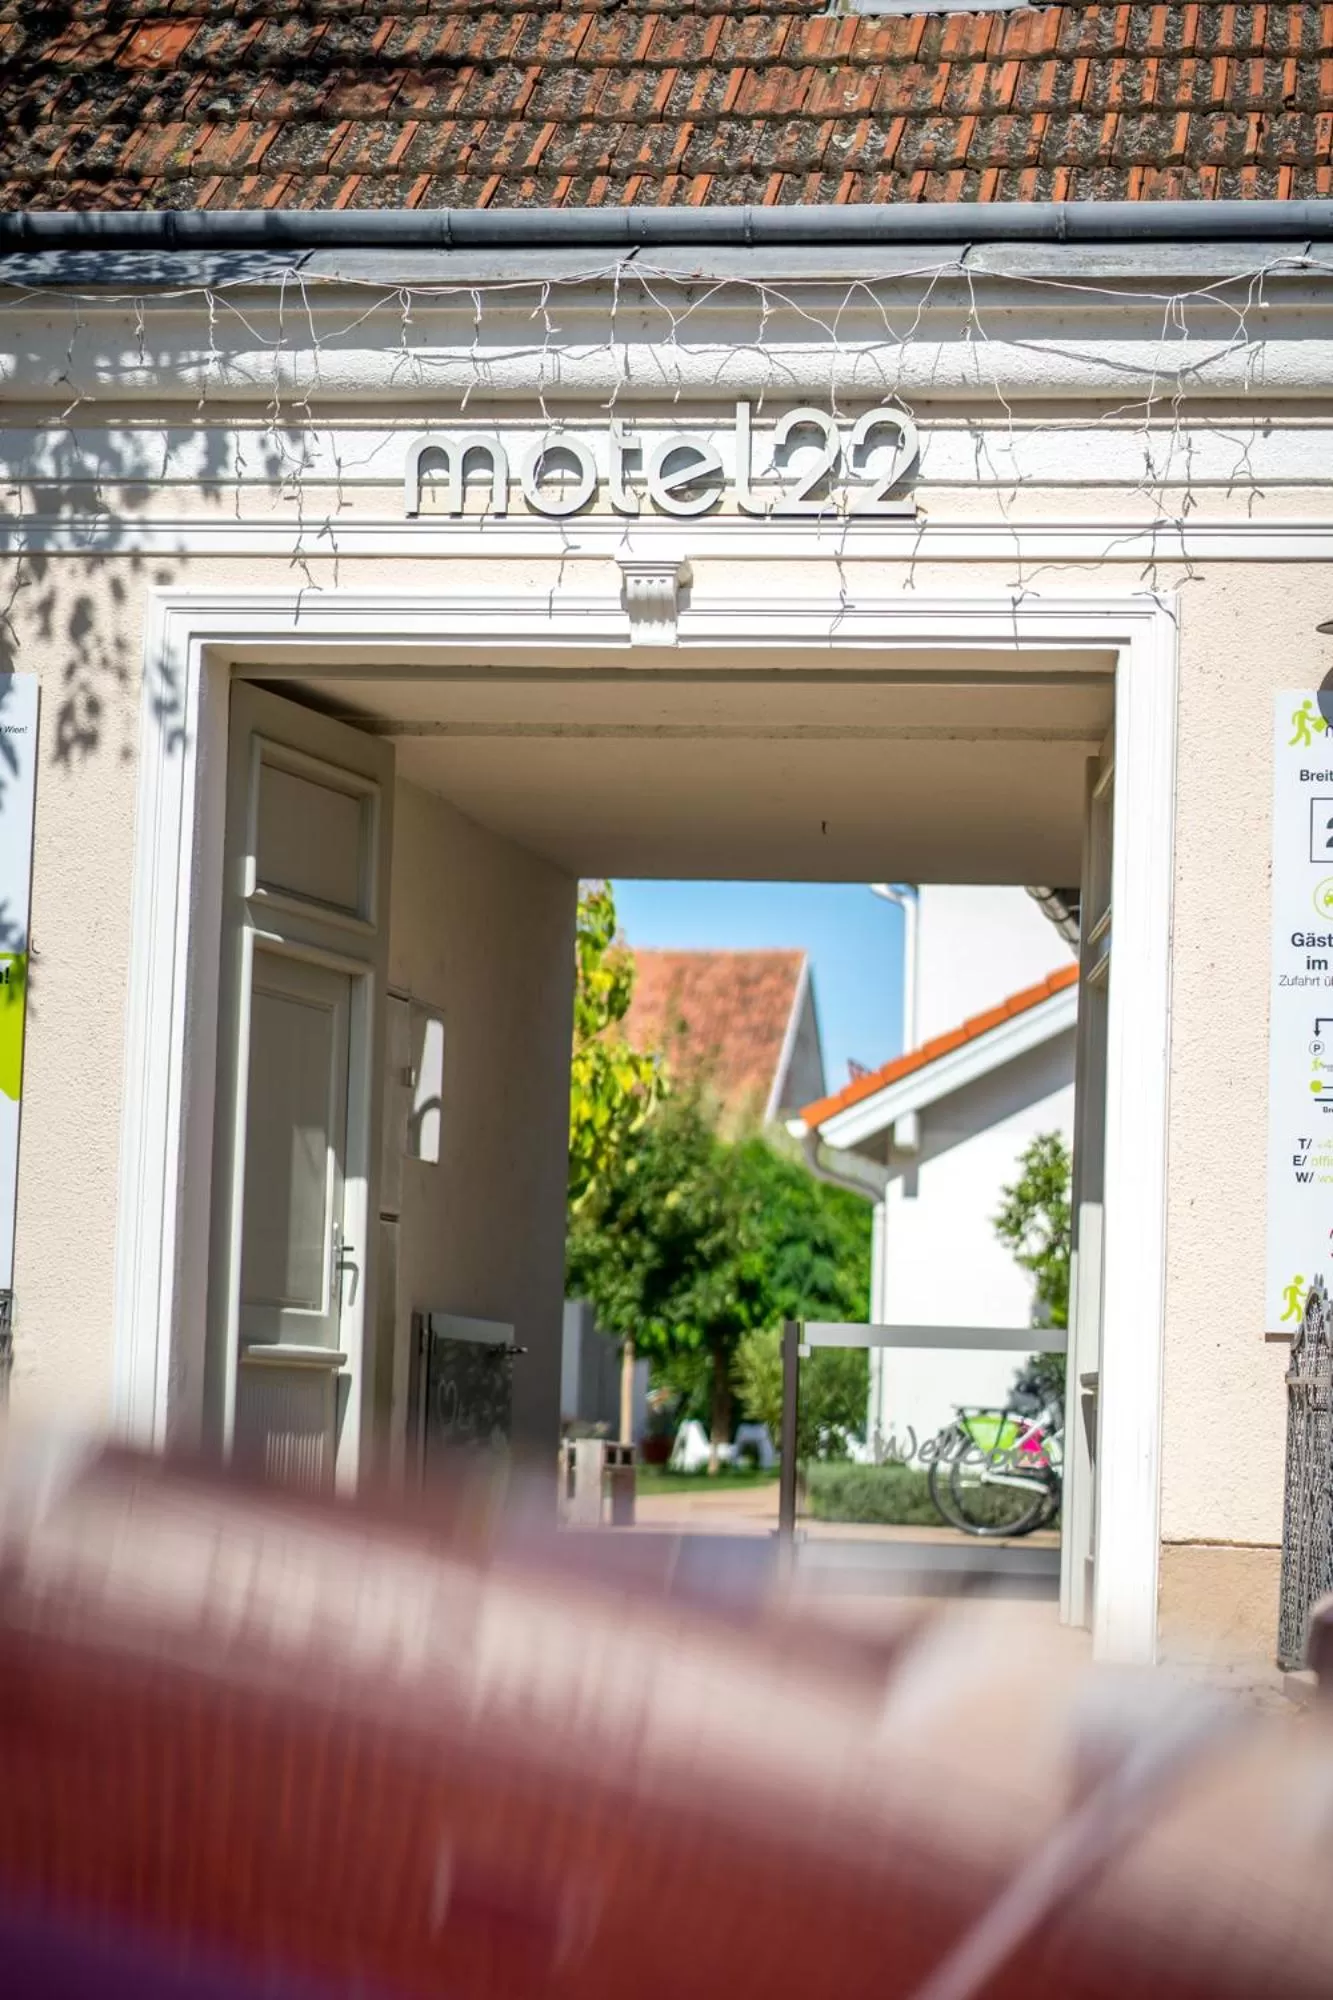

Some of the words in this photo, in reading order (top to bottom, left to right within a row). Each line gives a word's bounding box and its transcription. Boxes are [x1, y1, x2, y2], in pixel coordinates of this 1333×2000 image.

[405, 402, 920, 517] motel22
[1306, 955, 1328, 970] im
[1279, 974, 1320, 986] Zufahrt
[1298, 1138, 1312, 1150] T/
[1293, 1155, 1307, 1166] E/
[1295, 1171, 1314, 1183] W/
[873, 1424, 1064, 1466] Welcom
